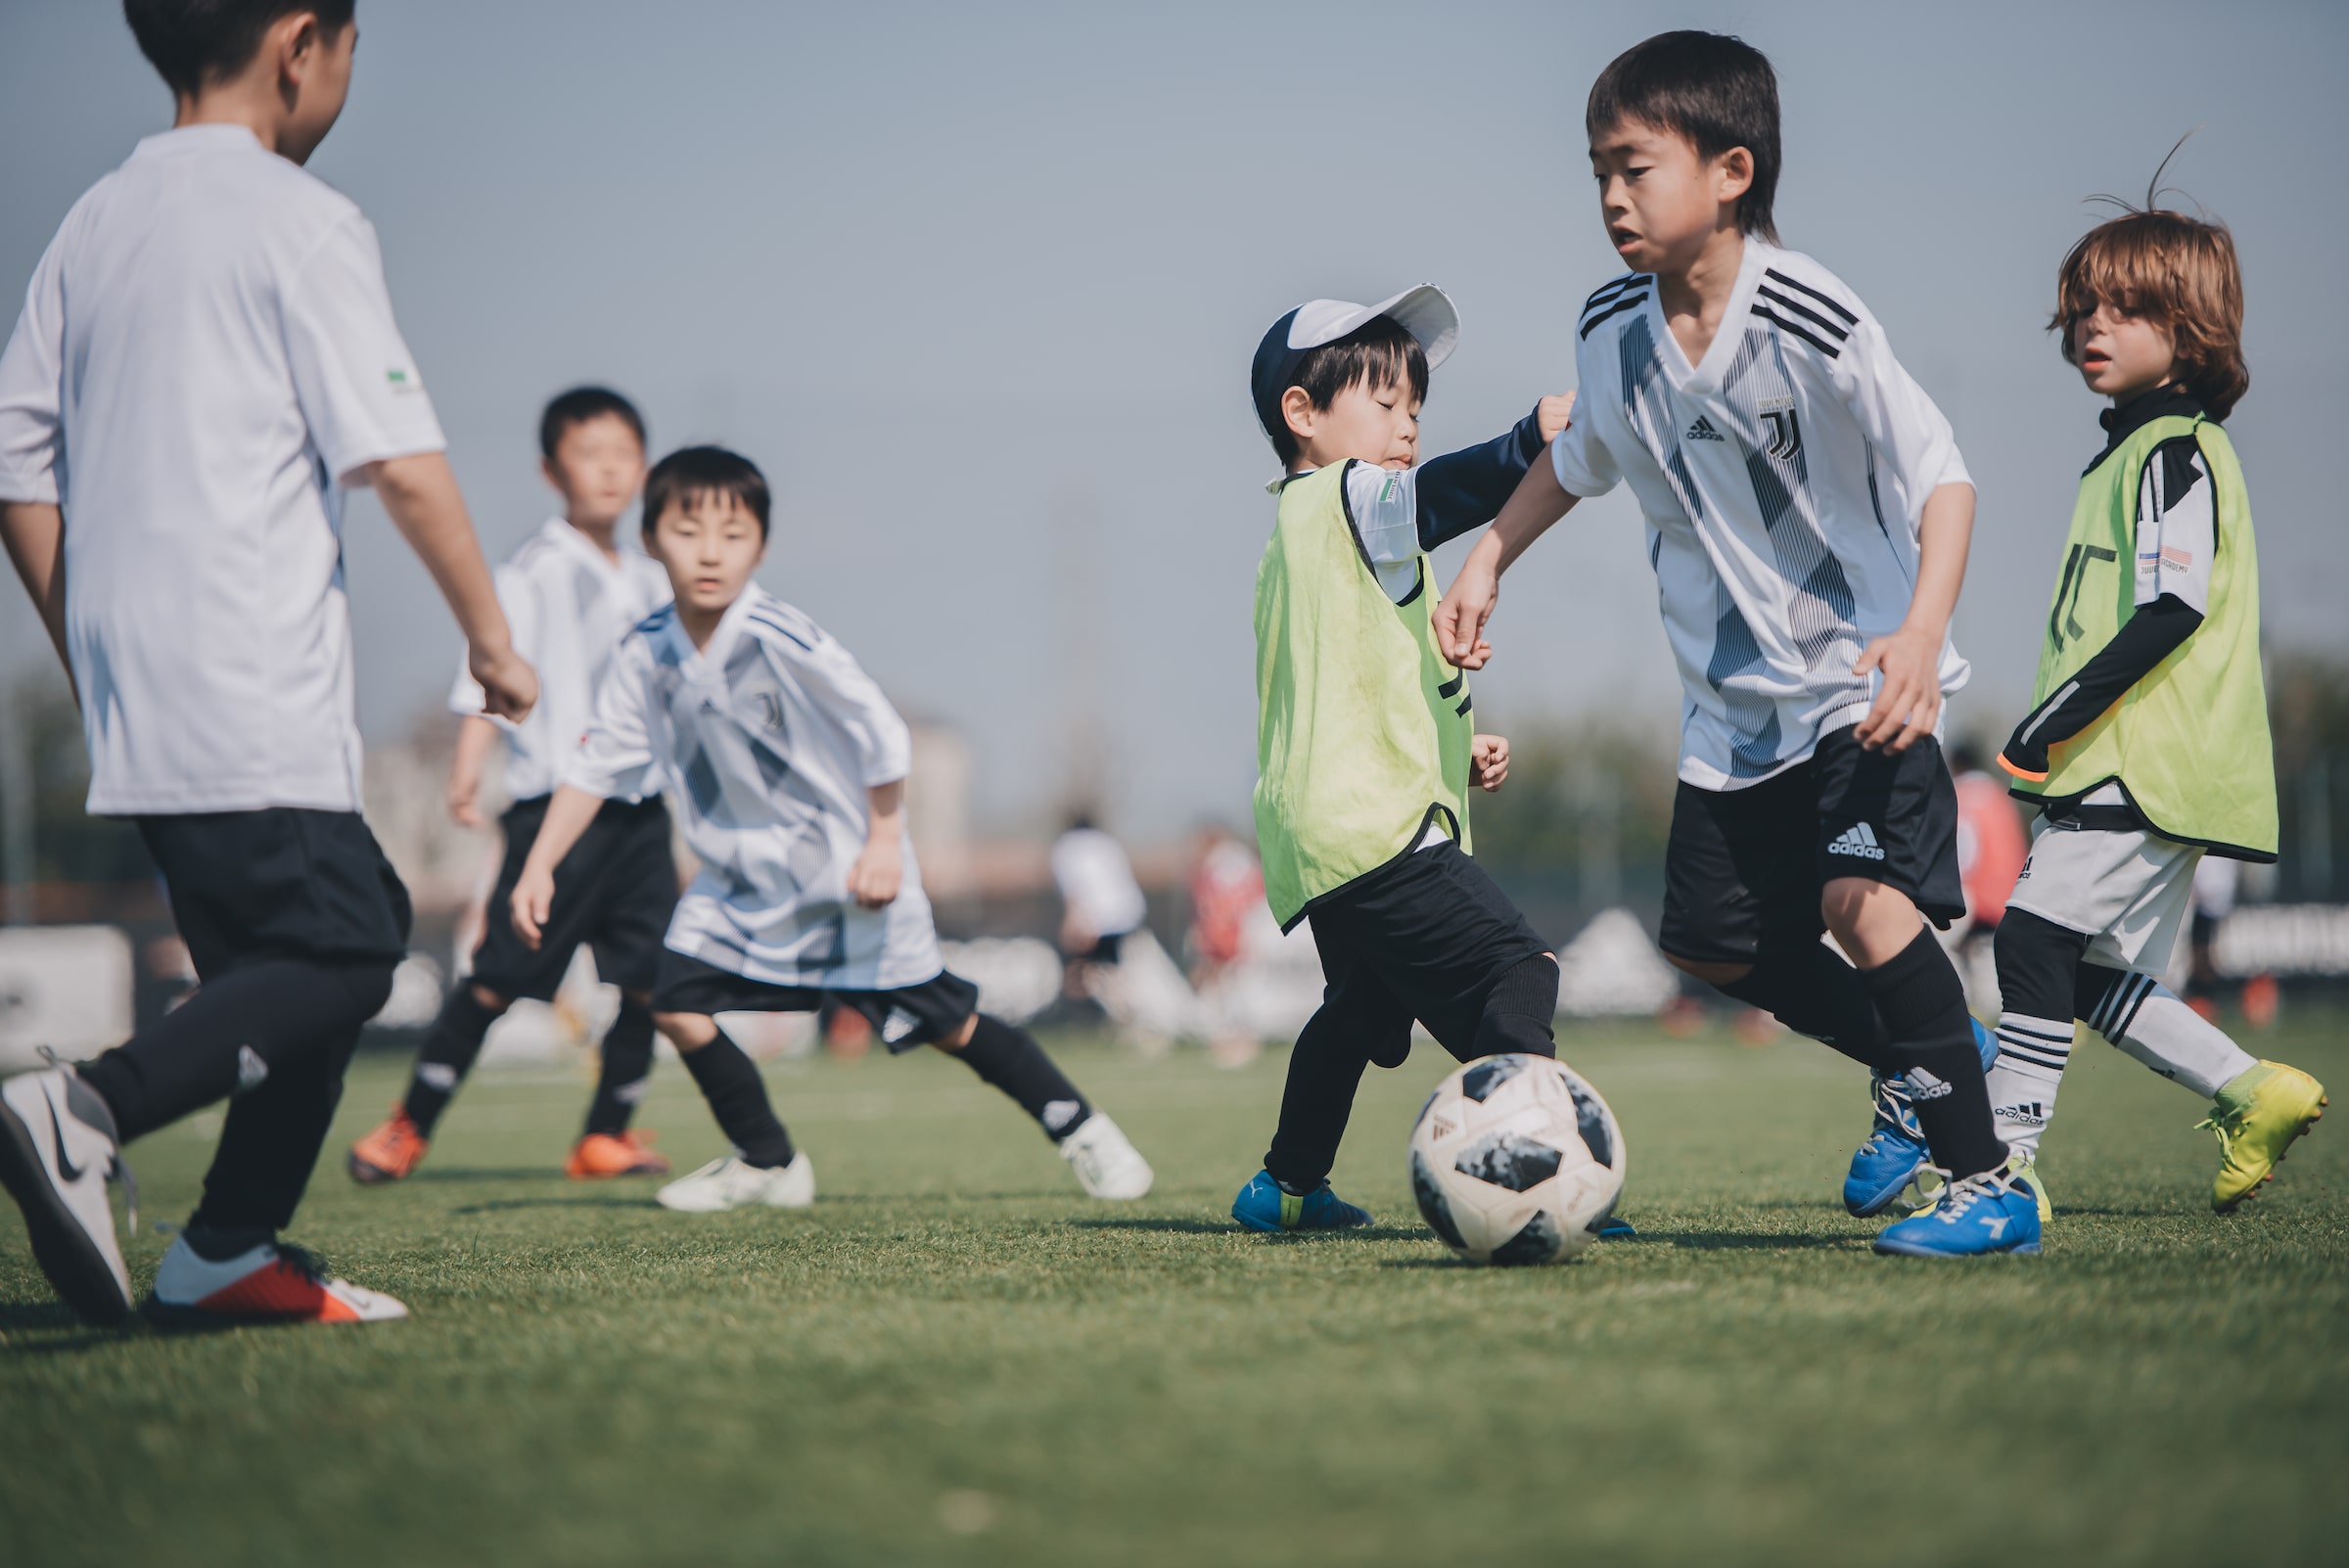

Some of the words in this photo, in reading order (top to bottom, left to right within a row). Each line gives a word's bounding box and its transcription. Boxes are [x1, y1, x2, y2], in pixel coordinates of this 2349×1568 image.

[1686, 430, 1726, 442] adidas
[1827, 841, 1885, 860] adidas
[1995, 1106, 2045, 1126] adidas
